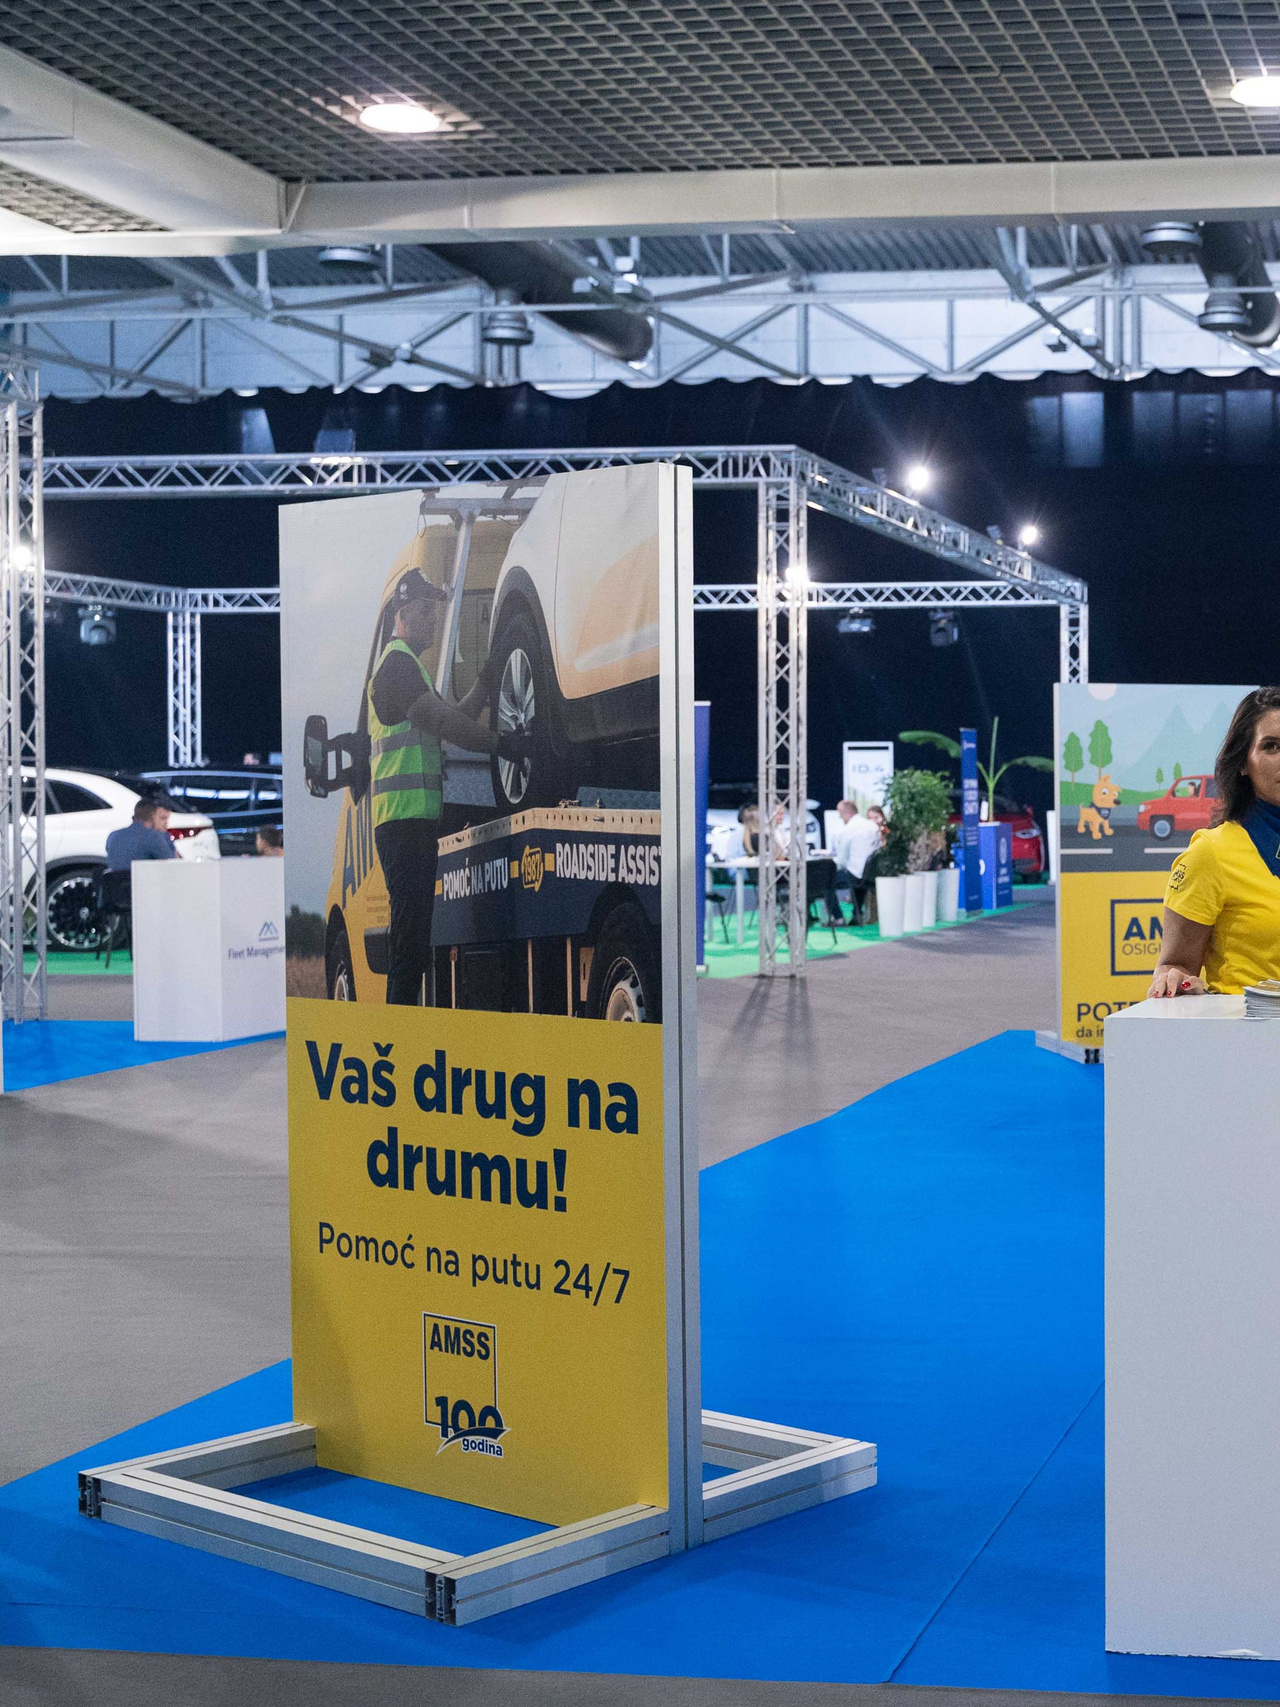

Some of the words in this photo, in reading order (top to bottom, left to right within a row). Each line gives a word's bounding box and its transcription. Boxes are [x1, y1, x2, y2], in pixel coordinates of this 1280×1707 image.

[443, 857, 471, 901] POMOĆ
[471, 868, 483, 895] NA
[484, 857, 508, 894] PUTU
[523, 853, 541, 882] 1987
[556, 842, 616, 882] ROADSIDE
[618, 844, 661, 886] ASSIS
[305, 1040, 397, 1108] Vaš
[414, 1049, 546, 1138] drug
[567, 1078, 639, 1135] na
[367, 1126, 567, 1213] drumu!
[319, 1221, 416, 1270] Pomoć
[426, 1245, 460, 1277] na
[472, 1252, 541, 1288] putu
[554, 1259, 631, 1307] 24/7
[430, 1323, 490, 1361] AMSS
[435, 1396, 504, 1439] 100
[462, 1437, 503, 1458] godina
